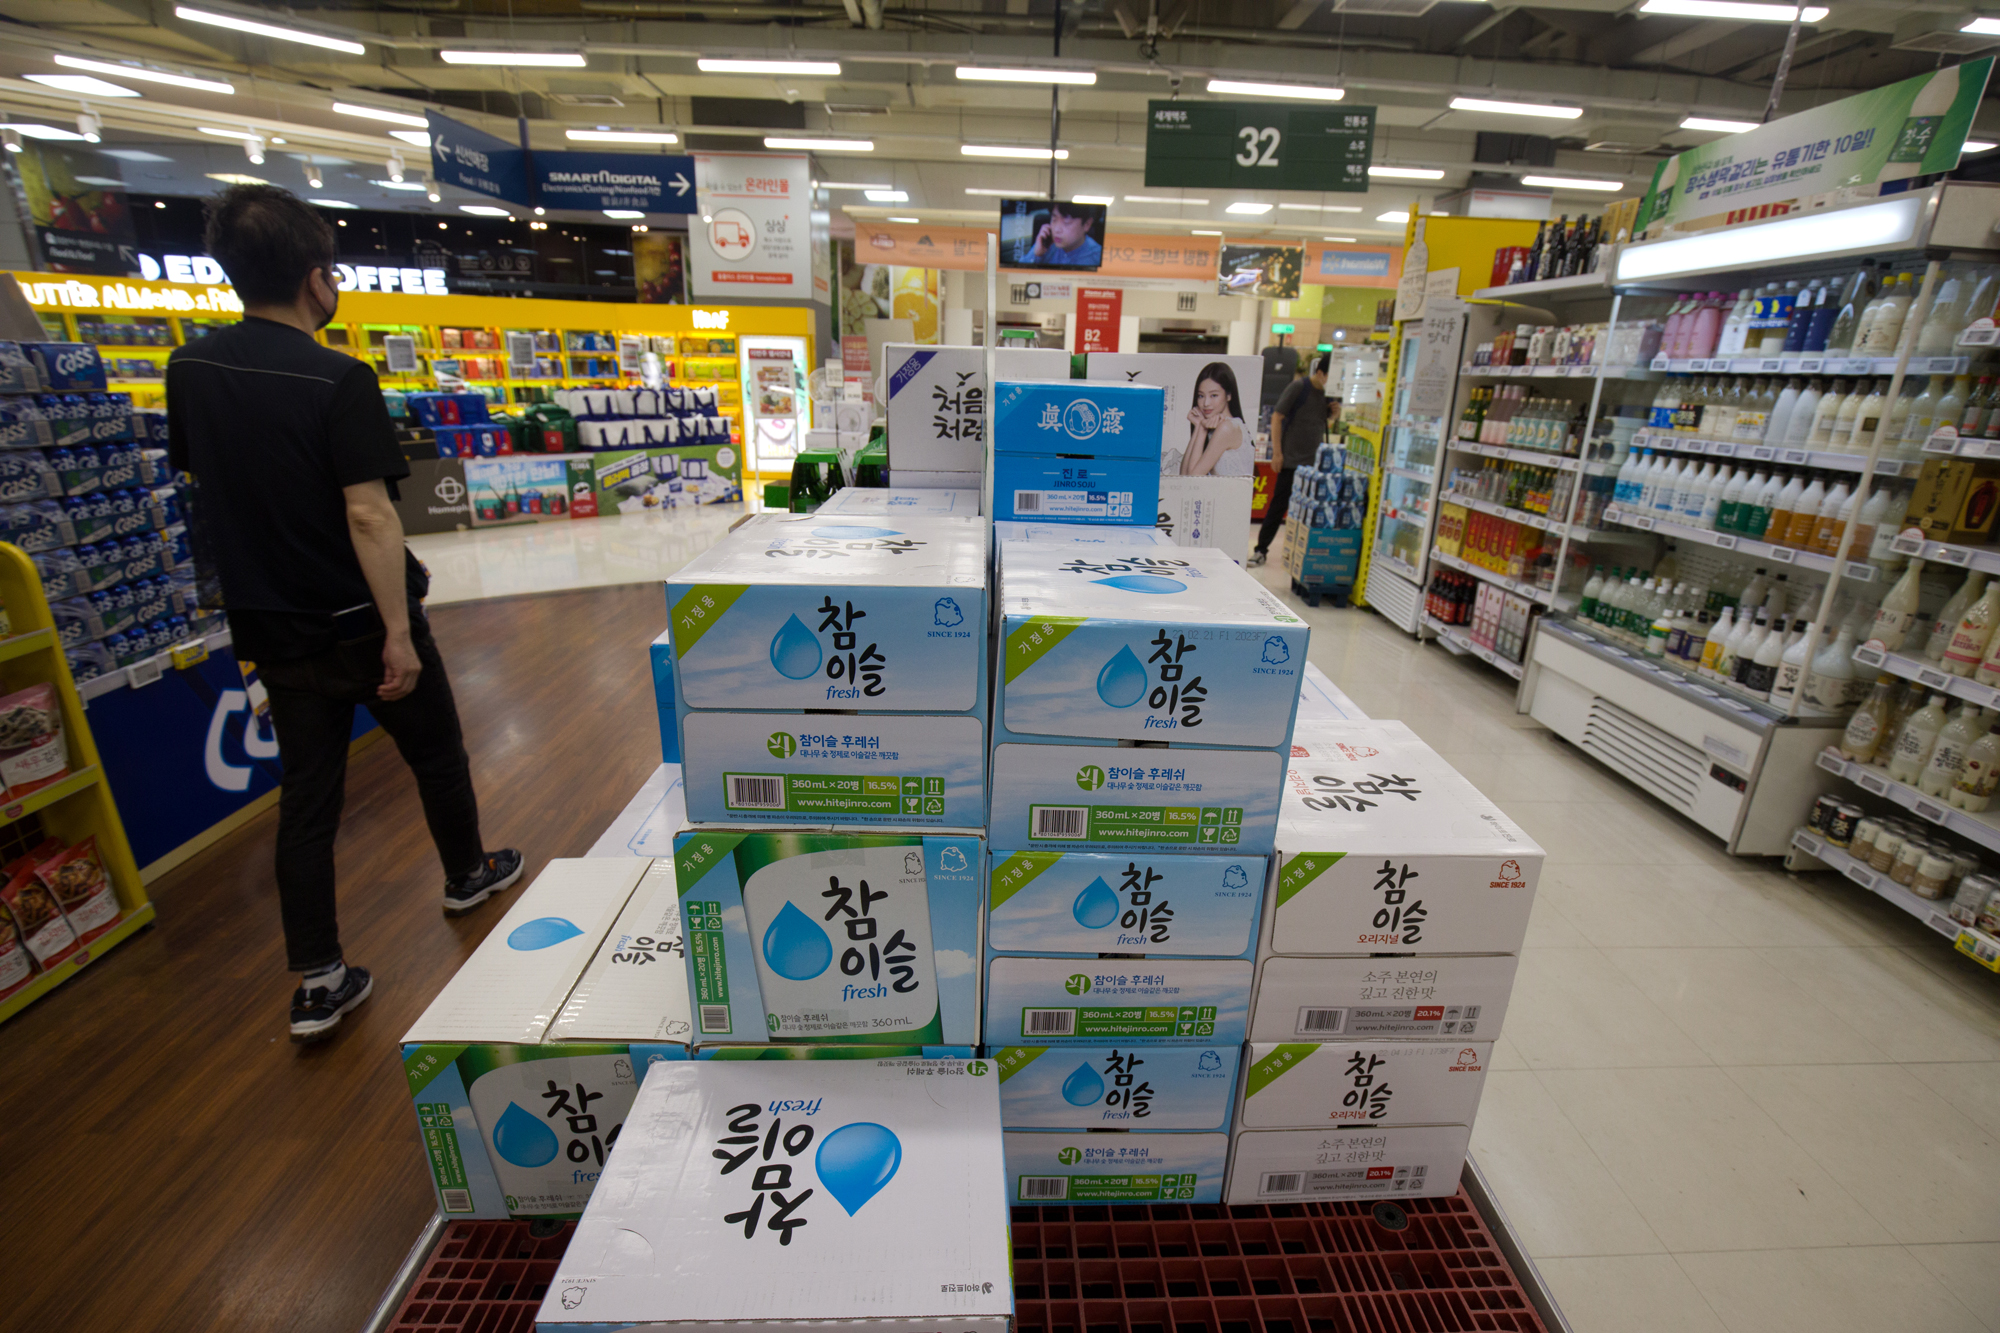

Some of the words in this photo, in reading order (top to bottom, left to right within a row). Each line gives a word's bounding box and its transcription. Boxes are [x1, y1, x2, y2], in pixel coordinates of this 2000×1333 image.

[1236, 126, 1281, 167] 32
[745, 177, 788, 193] 온라인몰
[17, 280, 101, 308] UTTER
[1085, 329, 1100, 342] B2
[895, 358, 922, 384] 가정용
[682, 594, 715, 629] 가정용
[1018, 623, 1055, 654] 가정용
[1252, 667, 1276, 675] SINCE
[826, 685, 860, 700] fresh
[1144, 715, 1177, 729] fresh
[799, 734, 839, 747] 참이슬
[841, 735, 880, 749] 후레쉬
[1108, 767, 1146, 780] 참이슬
[1148, 768, 1186, 781] 후레쉬
[867, 780, 897, 791] 16.5%
[797, 798, 892, 809] www.hitejinro.com
[1169, 812, 1196, 821] 16.5%
[1098, 828, 1189, 838] www.hitejinro.com
[682, 843, 714, 873] 가정용
[1001, 860, 1033, 886] 가정용
[1283, 860, 1316, 887] 가정용
[695, 932, 703, 954] 16.5%
[1117, 934, 1147, 945] fresh
[1357, 934, 1399, 944] 오리지널
[713, 936, 724, 998] www.hitejinro.com
[1094, 975, 1129, 986] 참이슬
[1131, 975, 1164, 986] 후레쉬
[1362, 971, 1392, 983] 소주
[1395, 970, 1438, 984] 본연의
[842, 983, 888, 1002] fresh
[1359, 988, 1388, 999] 깊고
[1392, 987, 1420, 1000] 진한
[1422, 987, 1436, 1000] 맛
[780, 1014, 801, 1023] 참이슬
[1085, 1025, 1168, 1034] www.hitejinro.com
[409, 1053, 437, 1079] 가정용
[998, 1050, 1026, 1073] 가정용
[1263, 1051, 1293, 1075] 가정용
[769, 1097, 823, 1116] fresh
[1103, 1110, 1130, 1120] fresh
[1329, 1110, 1366, 1120] 오리지널
[1317, 1139, 1347, 1149] 소주
[1349, 1136, 1387, 1149] 본연의
[444, 1132, 464, 1184] www.hitejinro.com
[1084, 1148, 1116, 1157] 참이슬
[1316, 1153, 1341, 1164] 깊고
[1347, 1152, 1370, 1163] 진한
[1372, 1152, 1386, 1162] 맛
[1313, 1182, 1385, 1191] www.hitejinro.com
[1076, 1190, 1152, 1198] www.hitejinro.com
